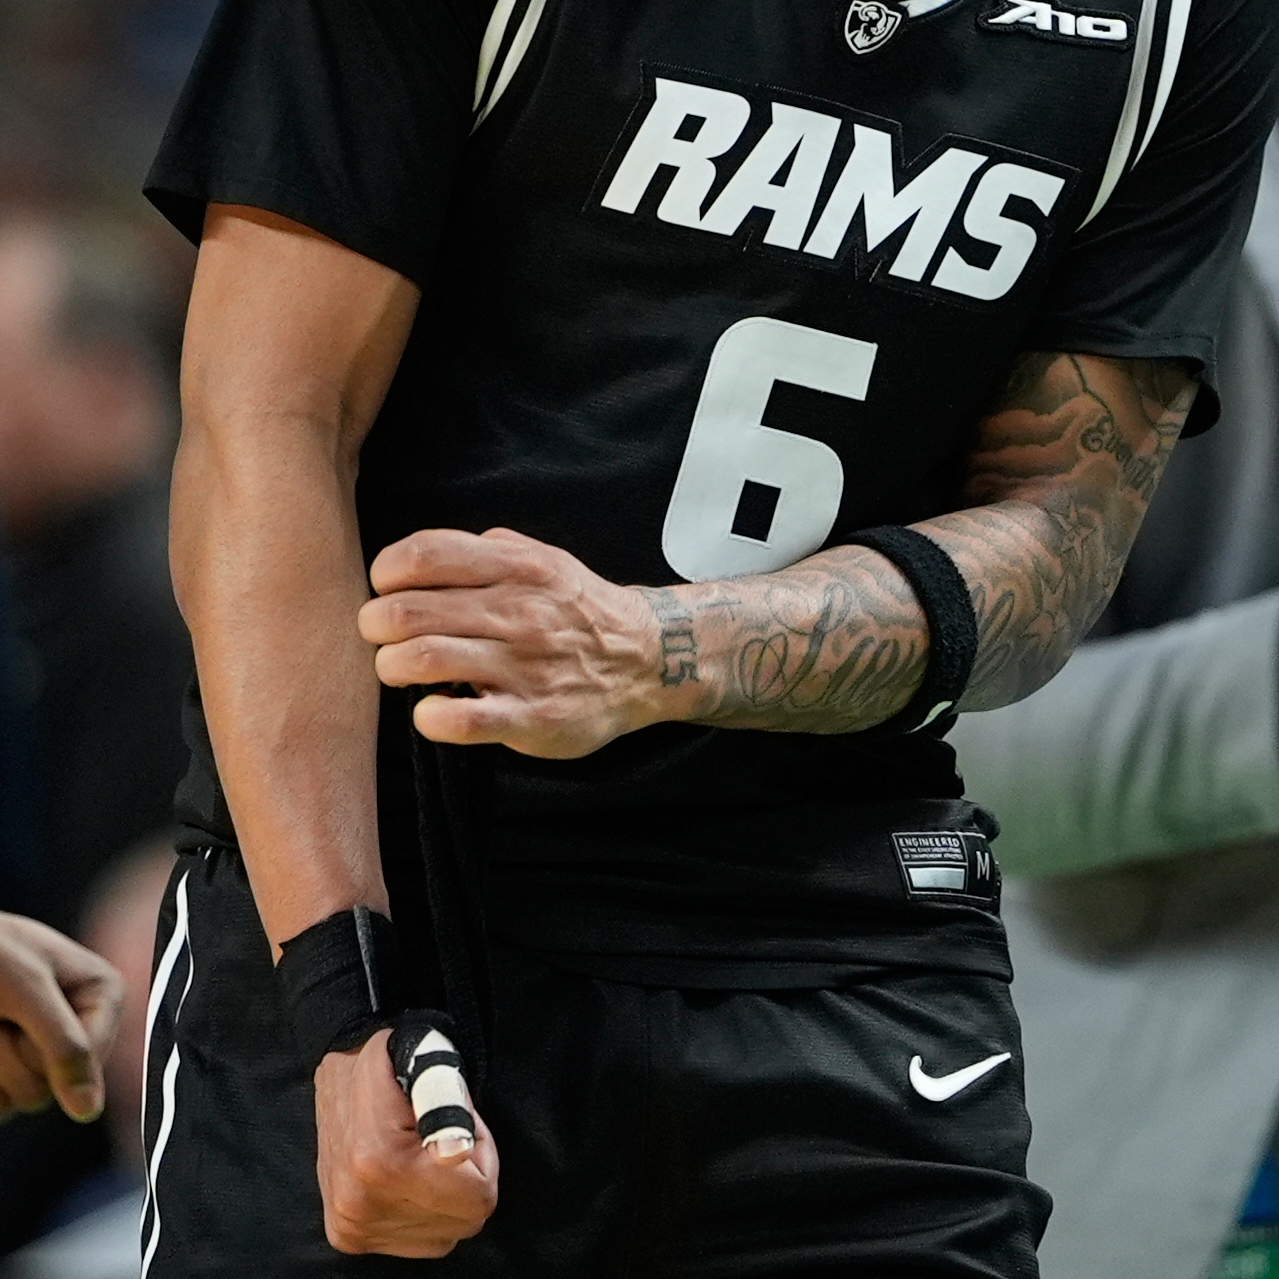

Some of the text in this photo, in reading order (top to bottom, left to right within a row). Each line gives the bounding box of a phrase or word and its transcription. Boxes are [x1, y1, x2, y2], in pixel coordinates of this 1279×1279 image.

[601, 77, 1066, 301] RAMS
[661, 316, 878, 584] 6
[898, 837, 960, 847] ENGINEERED
[975, 850, 990, 881] M
